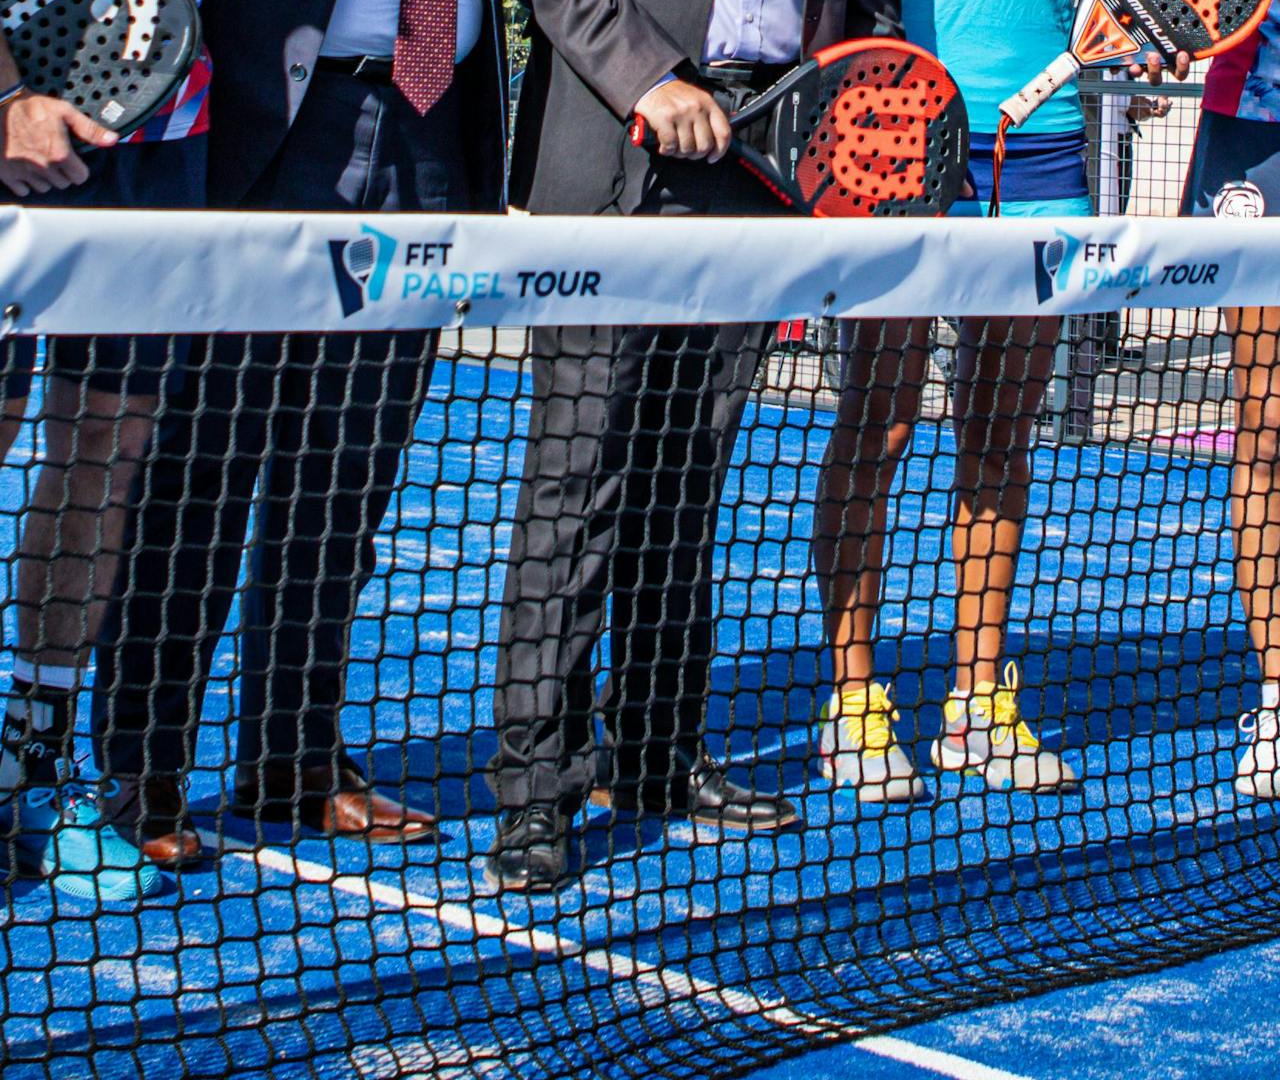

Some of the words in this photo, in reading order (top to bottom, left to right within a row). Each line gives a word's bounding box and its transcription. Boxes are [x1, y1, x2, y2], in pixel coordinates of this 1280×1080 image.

[405, 242, 453, 266] FFT
[1084, 243, 1117, 262] FFT
[401, 272, 505, 300] PADEL
[517, 271, 601, 297] TOUR
[1082, 265, 1152, 291] PADEL
[1160, 263, 1220, 285] TOUR
